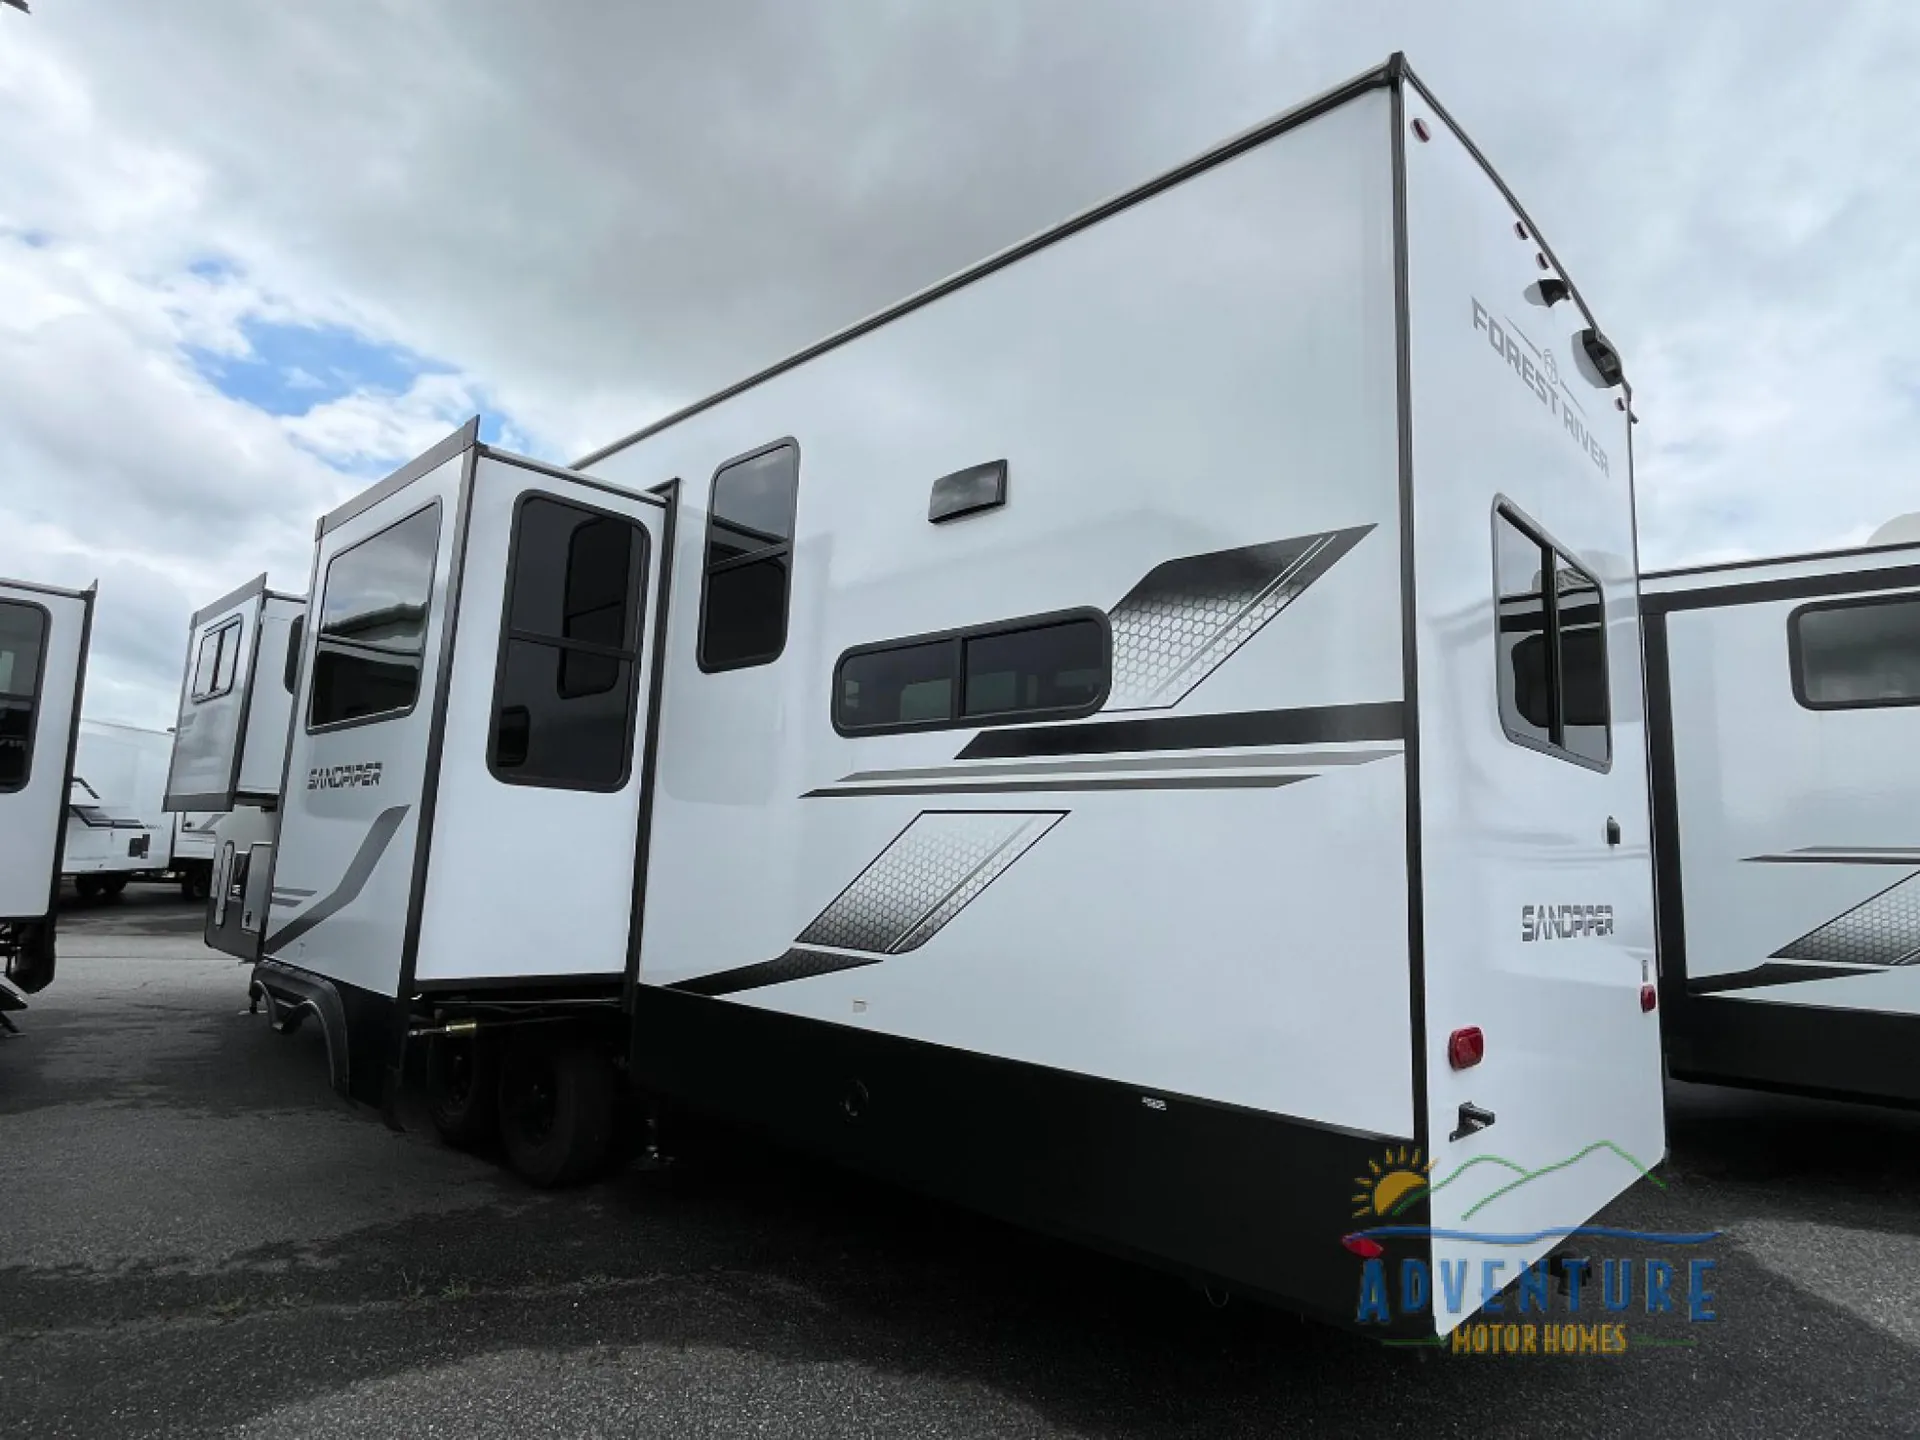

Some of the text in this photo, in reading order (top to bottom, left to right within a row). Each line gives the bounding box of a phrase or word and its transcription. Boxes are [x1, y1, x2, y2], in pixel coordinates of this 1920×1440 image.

[1471, 296, 1610, 478] FOREST RIVER
[307, 762, 383, 790] SANDPIPER
[1522, 905, 1613, 942] SANDPIPER
